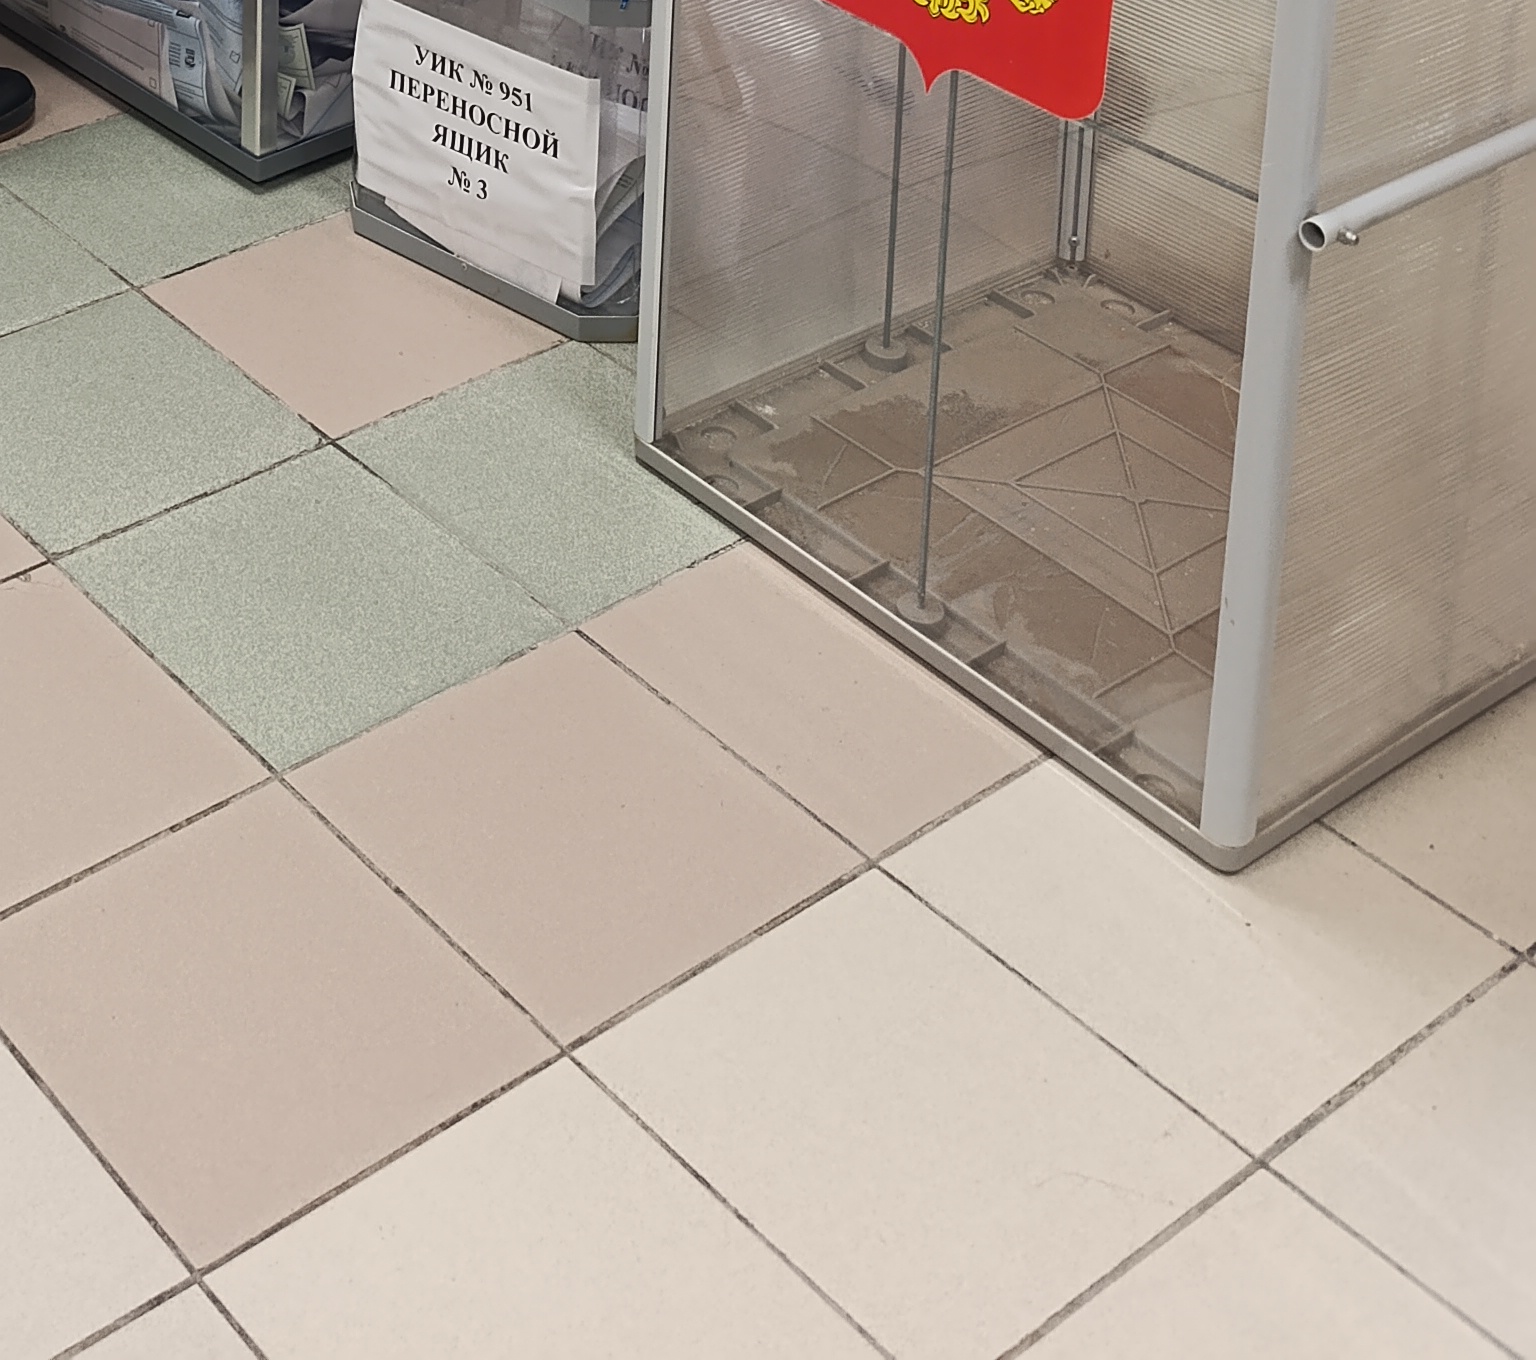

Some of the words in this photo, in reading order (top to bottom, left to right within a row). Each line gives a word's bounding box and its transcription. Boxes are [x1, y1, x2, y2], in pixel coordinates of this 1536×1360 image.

[414, 44, 465, 83] УИК
[469, 68, 495, 96] №
[499, 81, 534, 113] 951
[388, 68, 560, 160] ПЕРЕНОСНОЙ
[431, 123, 511, 175] ЯЩИК
[447, 165, 472, 193] №
[475, 178, 490, 201] 3
